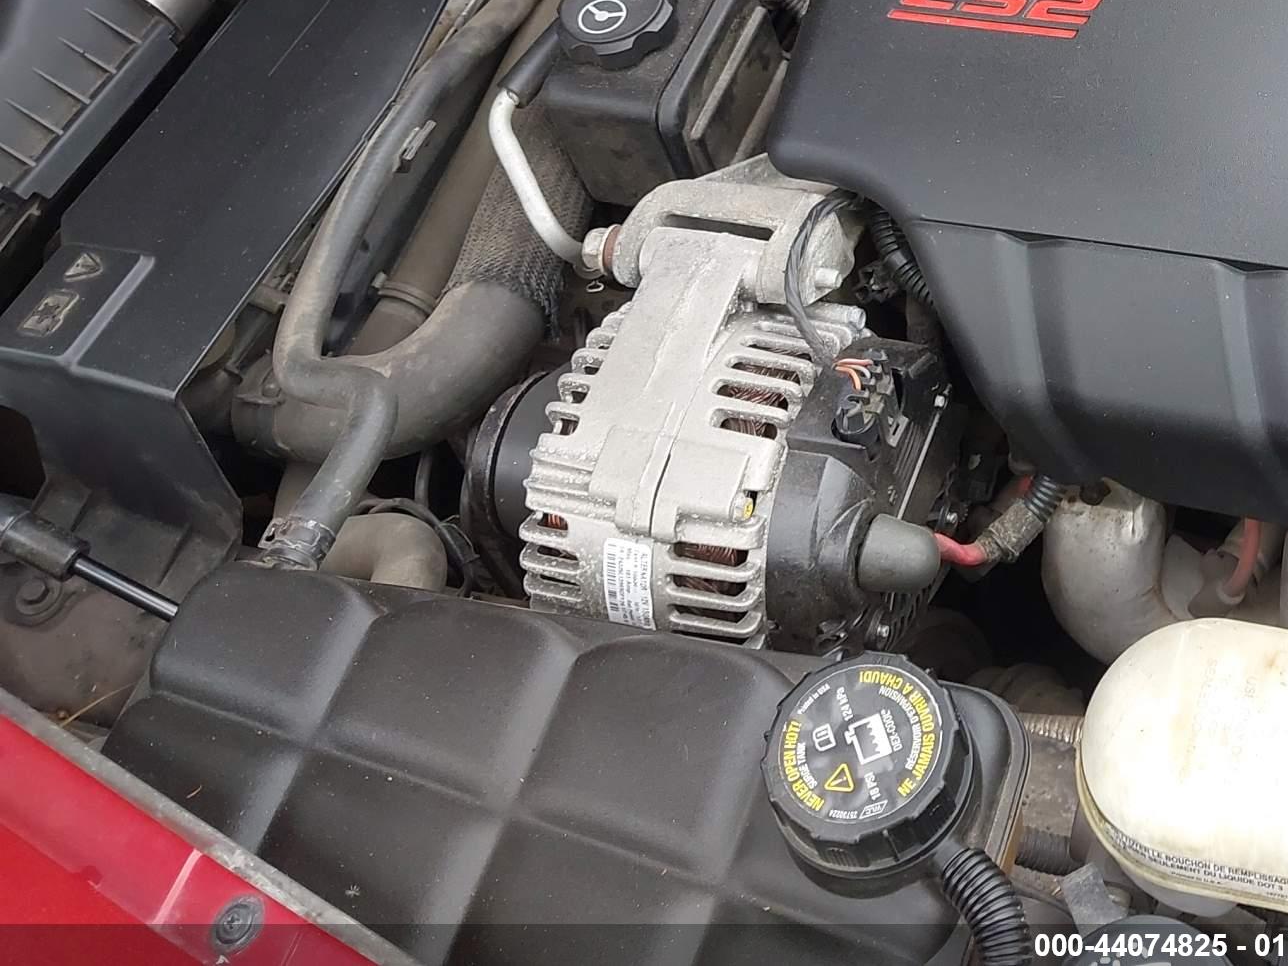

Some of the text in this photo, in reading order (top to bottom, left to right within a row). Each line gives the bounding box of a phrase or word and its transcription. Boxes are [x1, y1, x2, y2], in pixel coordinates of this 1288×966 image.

[859, 670, 904, 689] CHAUD!
[840, 703, 854, 721] 124
[911, 691, 935, 733] OUVRIR
[783, 721, 825, 812] NEVER OPEN HOT!
[796, 741, 818, 790] SURGE TANK
[912, 733, 936, 780] JAMAIS
[864, 771, 882, 801] 18 PSI
[898, 778, 917, 797] NE
[1165, 854, 1211, 870] BOUCHON
[1219, 874, 1255, 885] LIQUIDE
